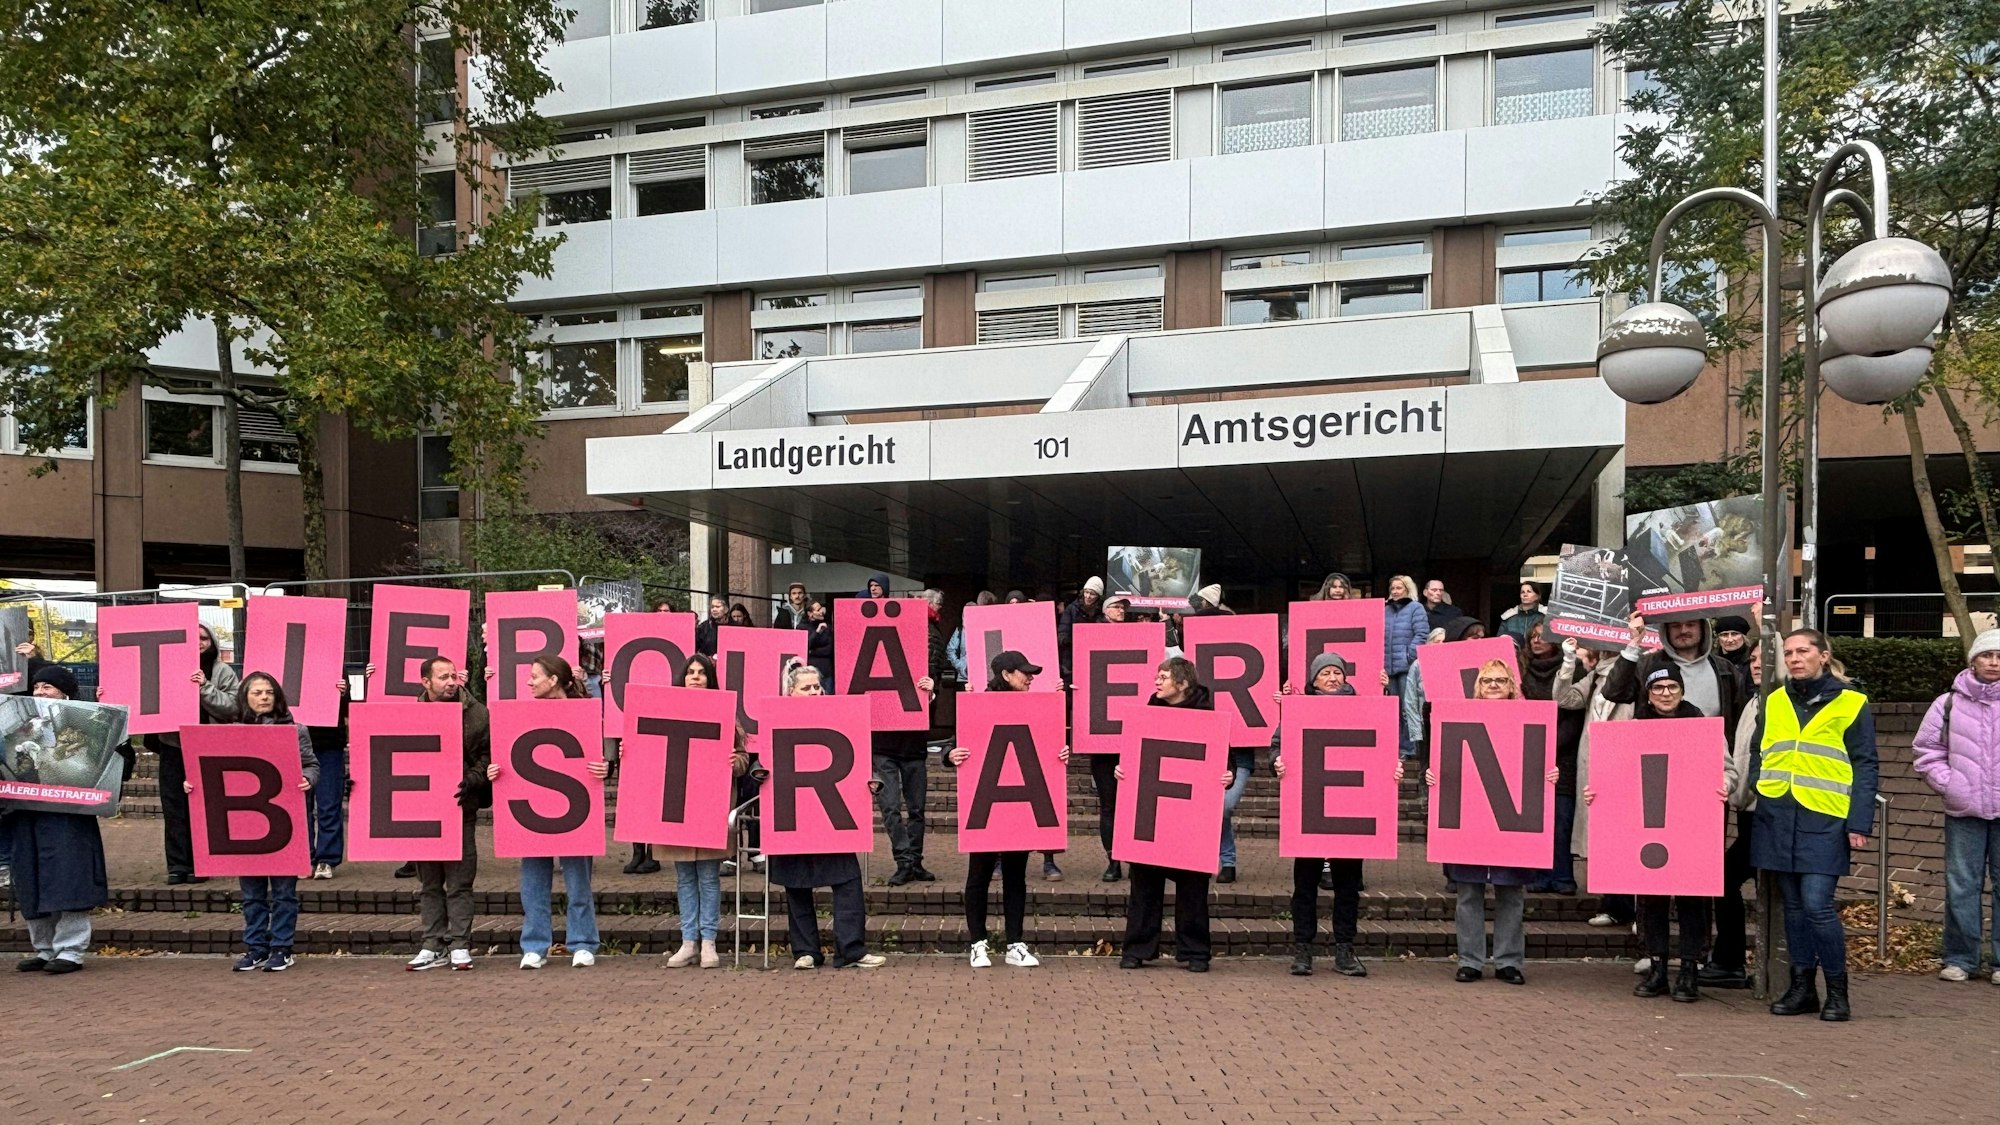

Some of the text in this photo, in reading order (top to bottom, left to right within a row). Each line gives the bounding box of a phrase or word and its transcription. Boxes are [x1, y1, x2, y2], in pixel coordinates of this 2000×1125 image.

[1181, 399, 1443, 449] Amtsgericht
[717, 434, 896, 475] Landgericht
[1033, 437, 1070, 460] 101
[1641, 588, 1763, 612] TIERQUÄLEREI BESTRAFE
[1556, 622, 1618, 640] TIERQUÄLEREI
[41, 787, 103, 801] BESTRAFEN!
